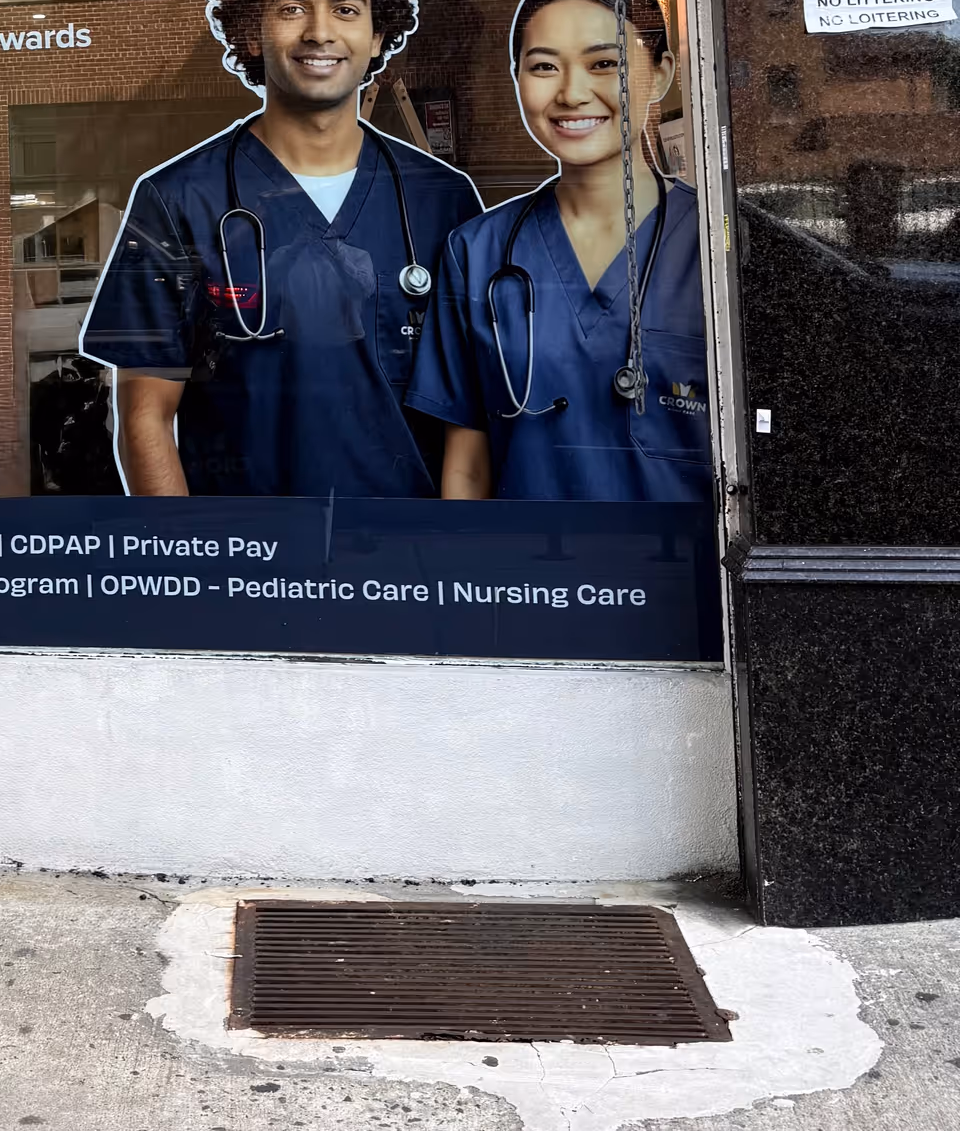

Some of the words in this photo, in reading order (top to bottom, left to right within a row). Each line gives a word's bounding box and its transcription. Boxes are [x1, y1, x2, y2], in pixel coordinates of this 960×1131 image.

[819, 15, 843, 27] NO
[848, 9, 940, 25] LOITERING
[659, 396, 706, 413] CROWN
[10, 534, 101, 555] CDPAP
[123, 534, 219, 557] Private
[228, 536, 278, 562] Pay
[100, 575, 200, 597] OPWDD
[228, 576, 355, 600] Pediatric
[362, 579, 429, 602] Care
[453, 582, 569, 609] Nursing
[576, 583, 646, 606] Care
